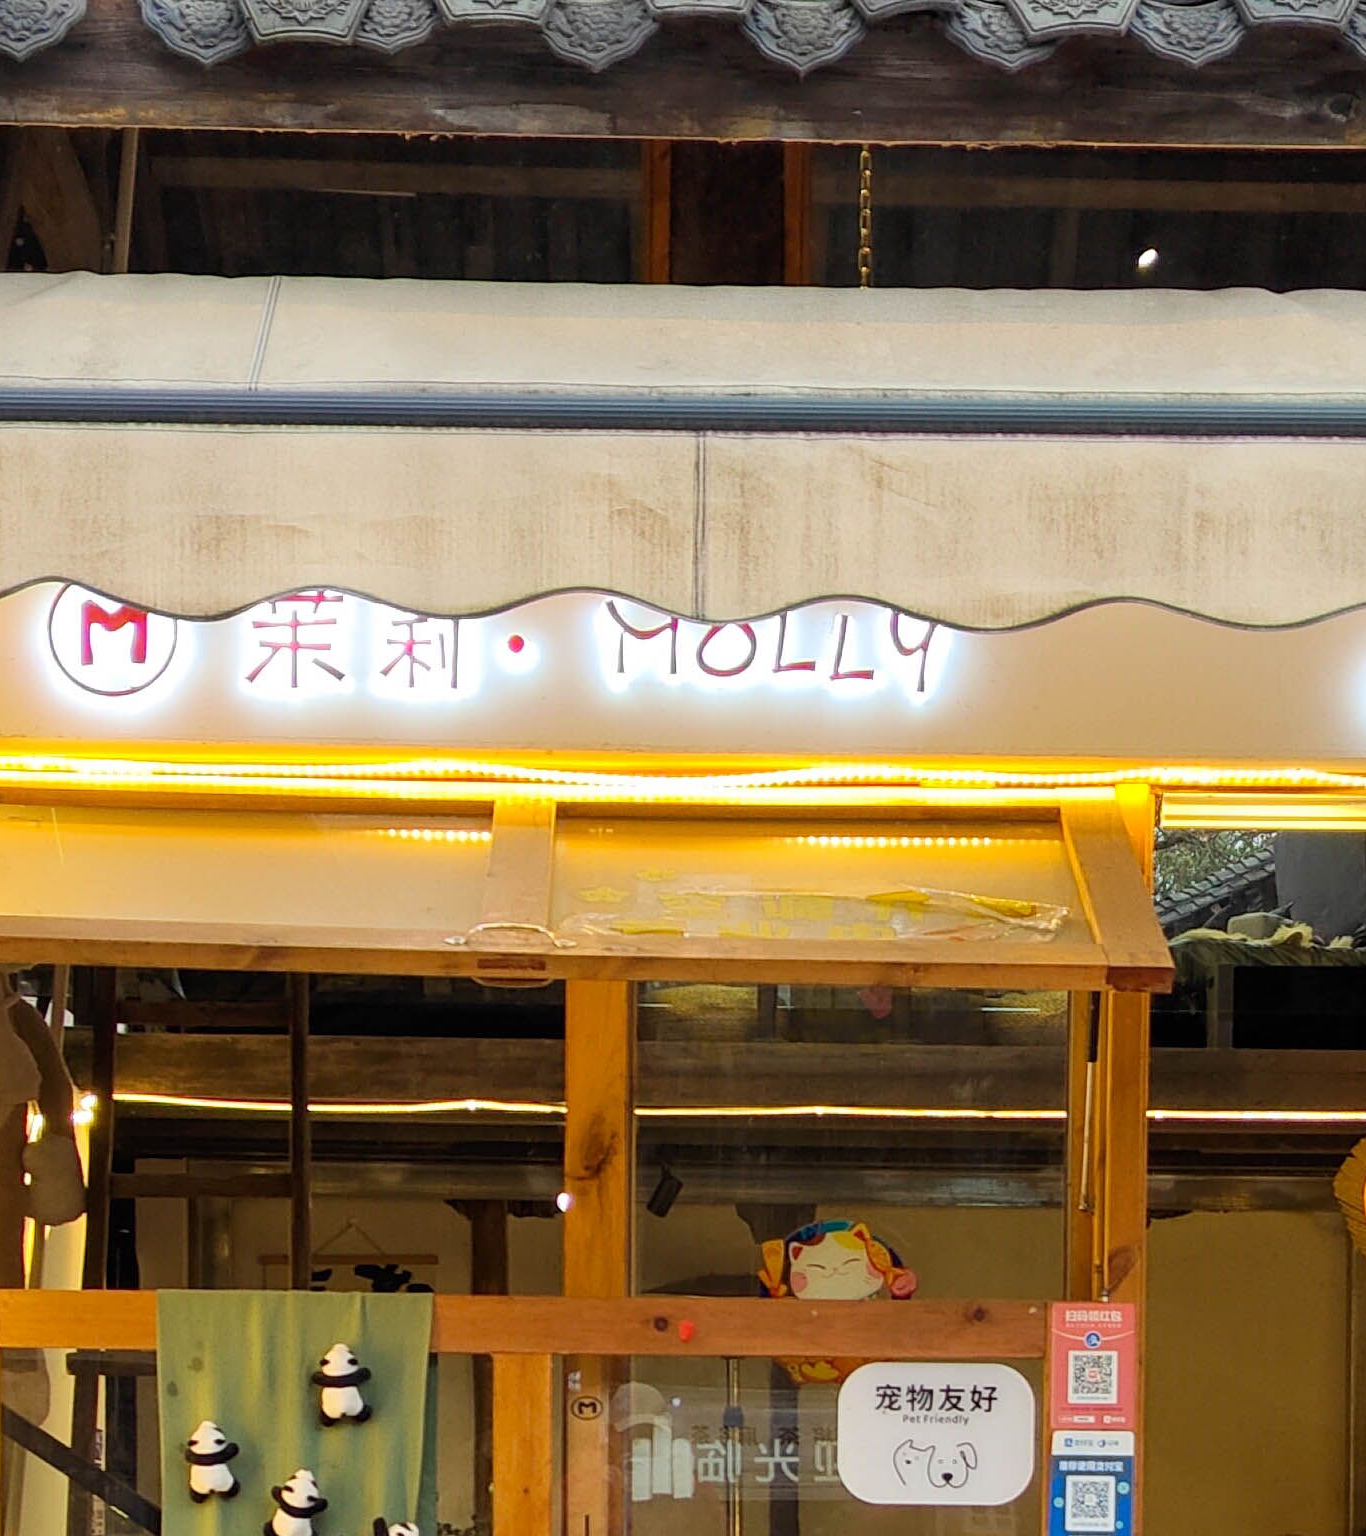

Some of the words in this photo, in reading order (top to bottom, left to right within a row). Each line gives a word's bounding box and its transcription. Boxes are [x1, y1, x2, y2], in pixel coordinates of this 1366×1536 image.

[874, 1384, 999, 1413] 宠物友好
[902, 1414, 922, 1424] Pet
[923, 1413, 970, 1427] Friendly
